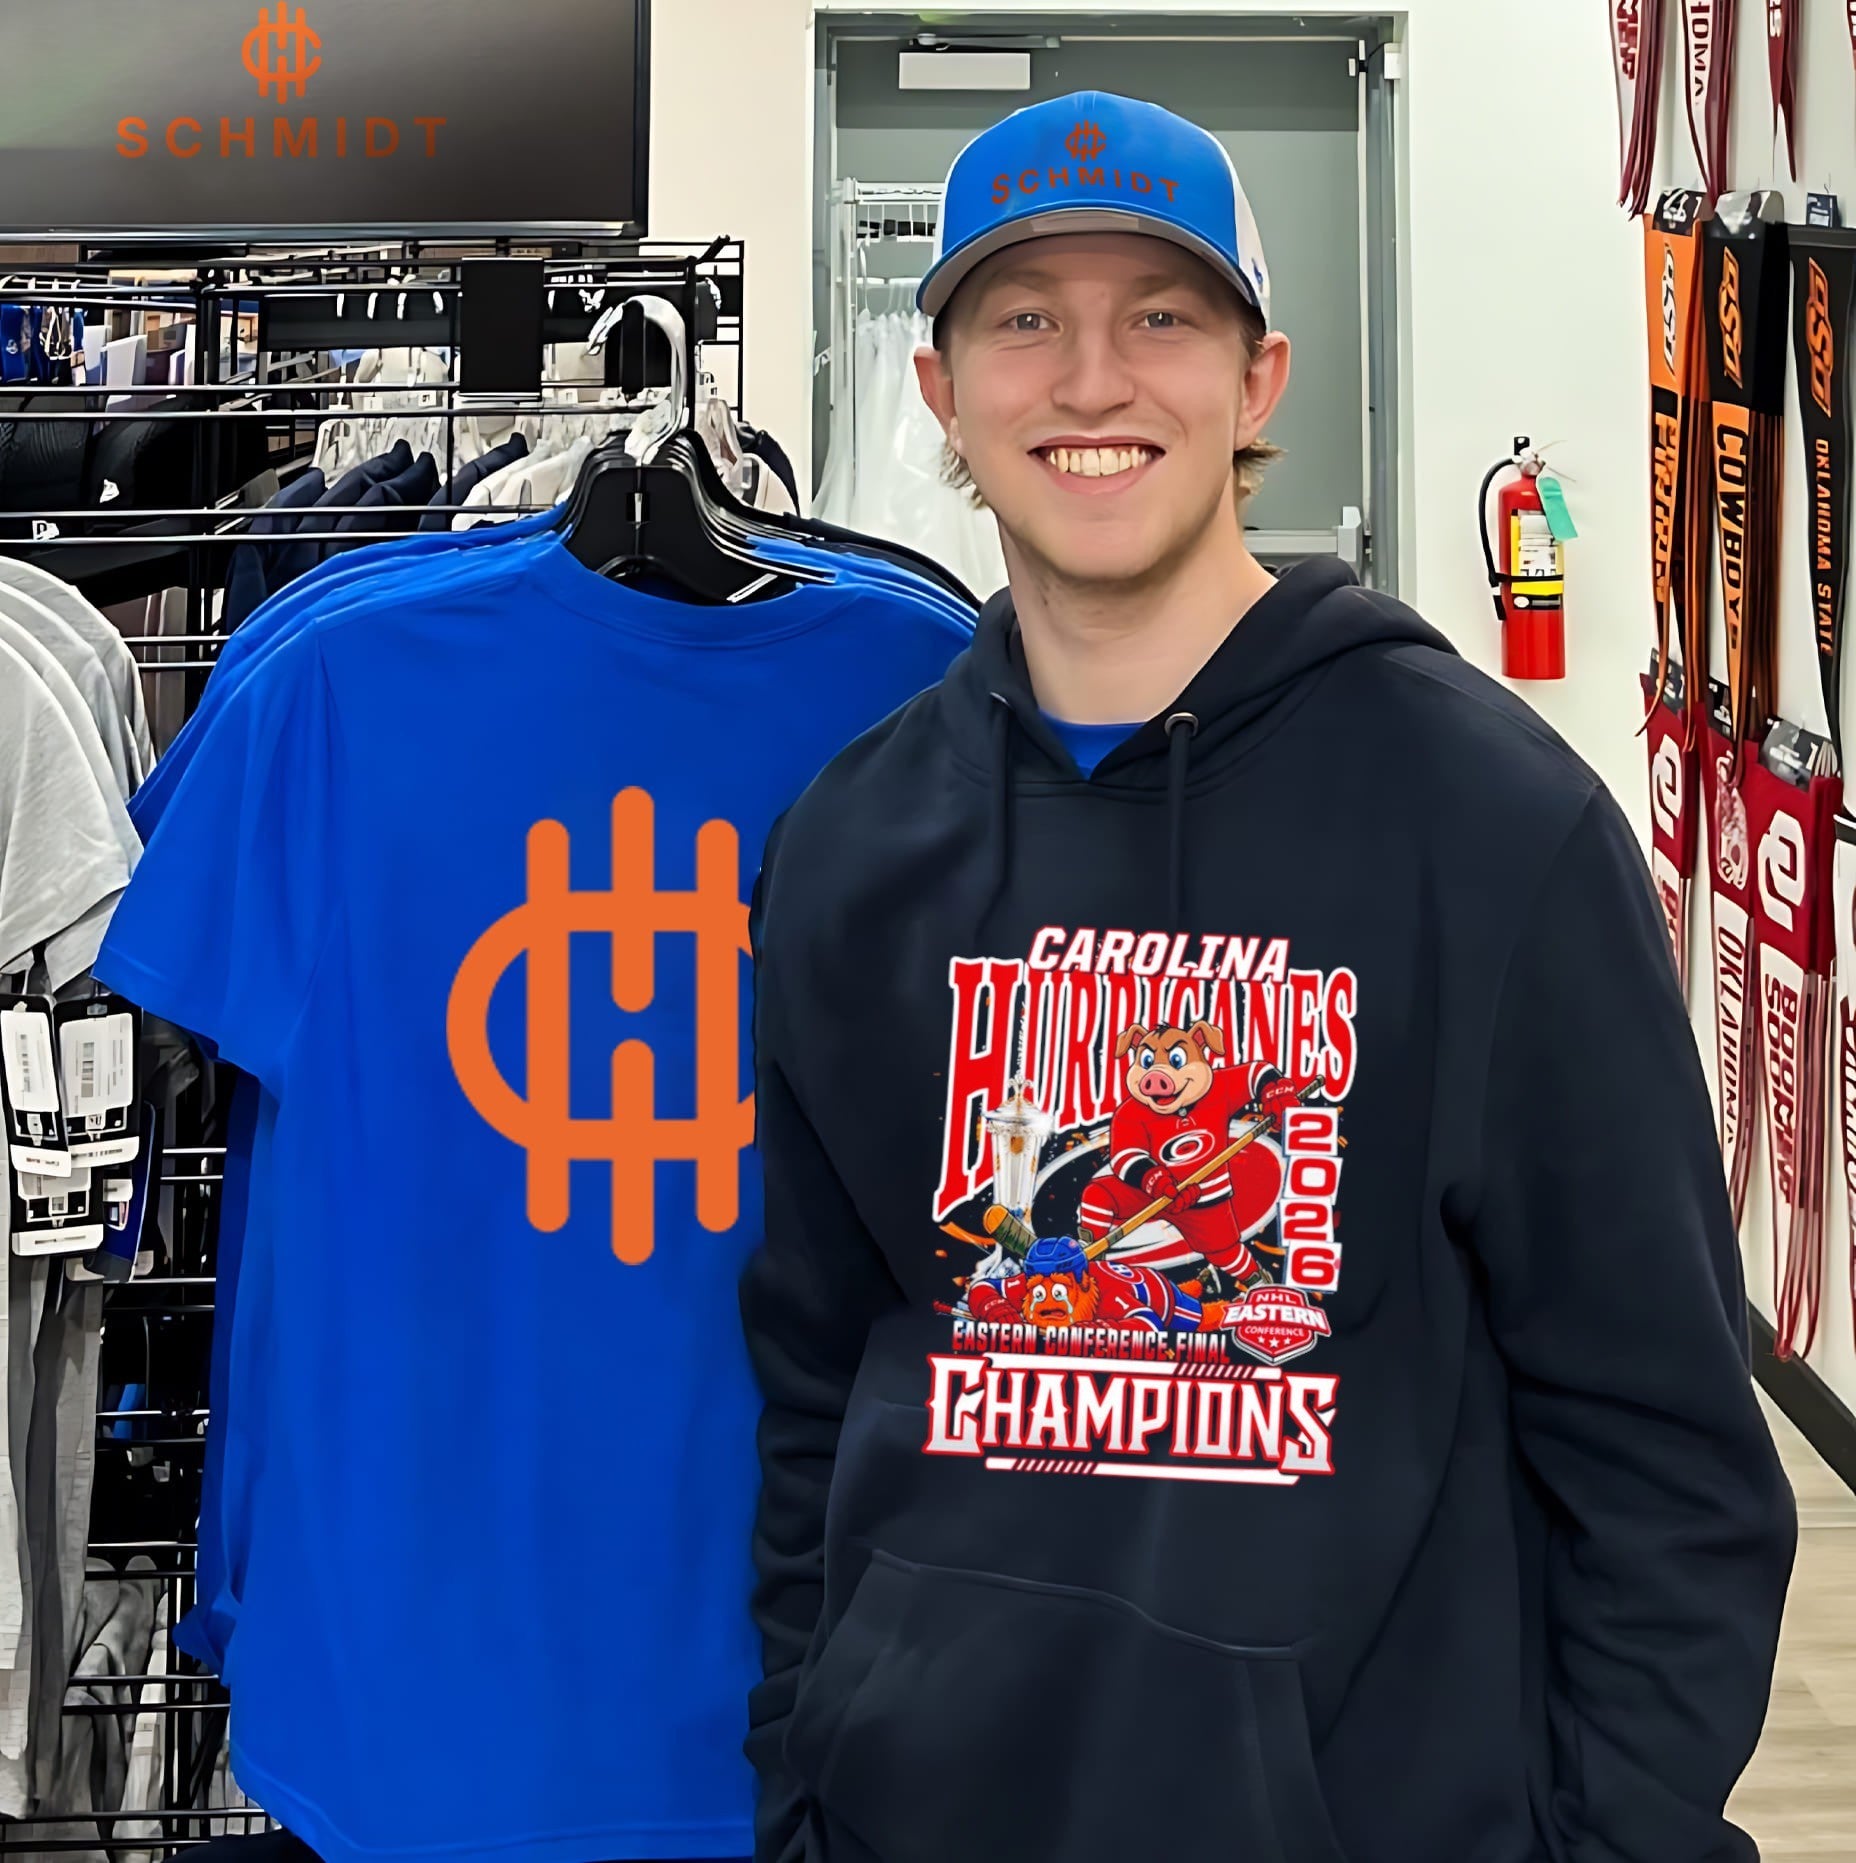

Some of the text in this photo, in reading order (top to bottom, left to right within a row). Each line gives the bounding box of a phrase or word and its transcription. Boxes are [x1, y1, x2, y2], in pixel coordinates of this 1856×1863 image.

[115, 117, 448, 160] SCHMIDT
[991, 165, 1181, 204] SCHMIDT
[1027, 925, 1291, 984] CAROLINA
[1265, 1085, 1295, 1099] CCM
[1223, 1303, 1326, 1331] EASTERN
[1256, 1293, 1298, 1305] NHL
[951, 1319, 1232, 1365] EASTERN CONFERENCE FINAL
[1244, 1325, 1306, 1337] CONFERENCE
[922, 1353, 1341, 1475] CHAMPIONS
